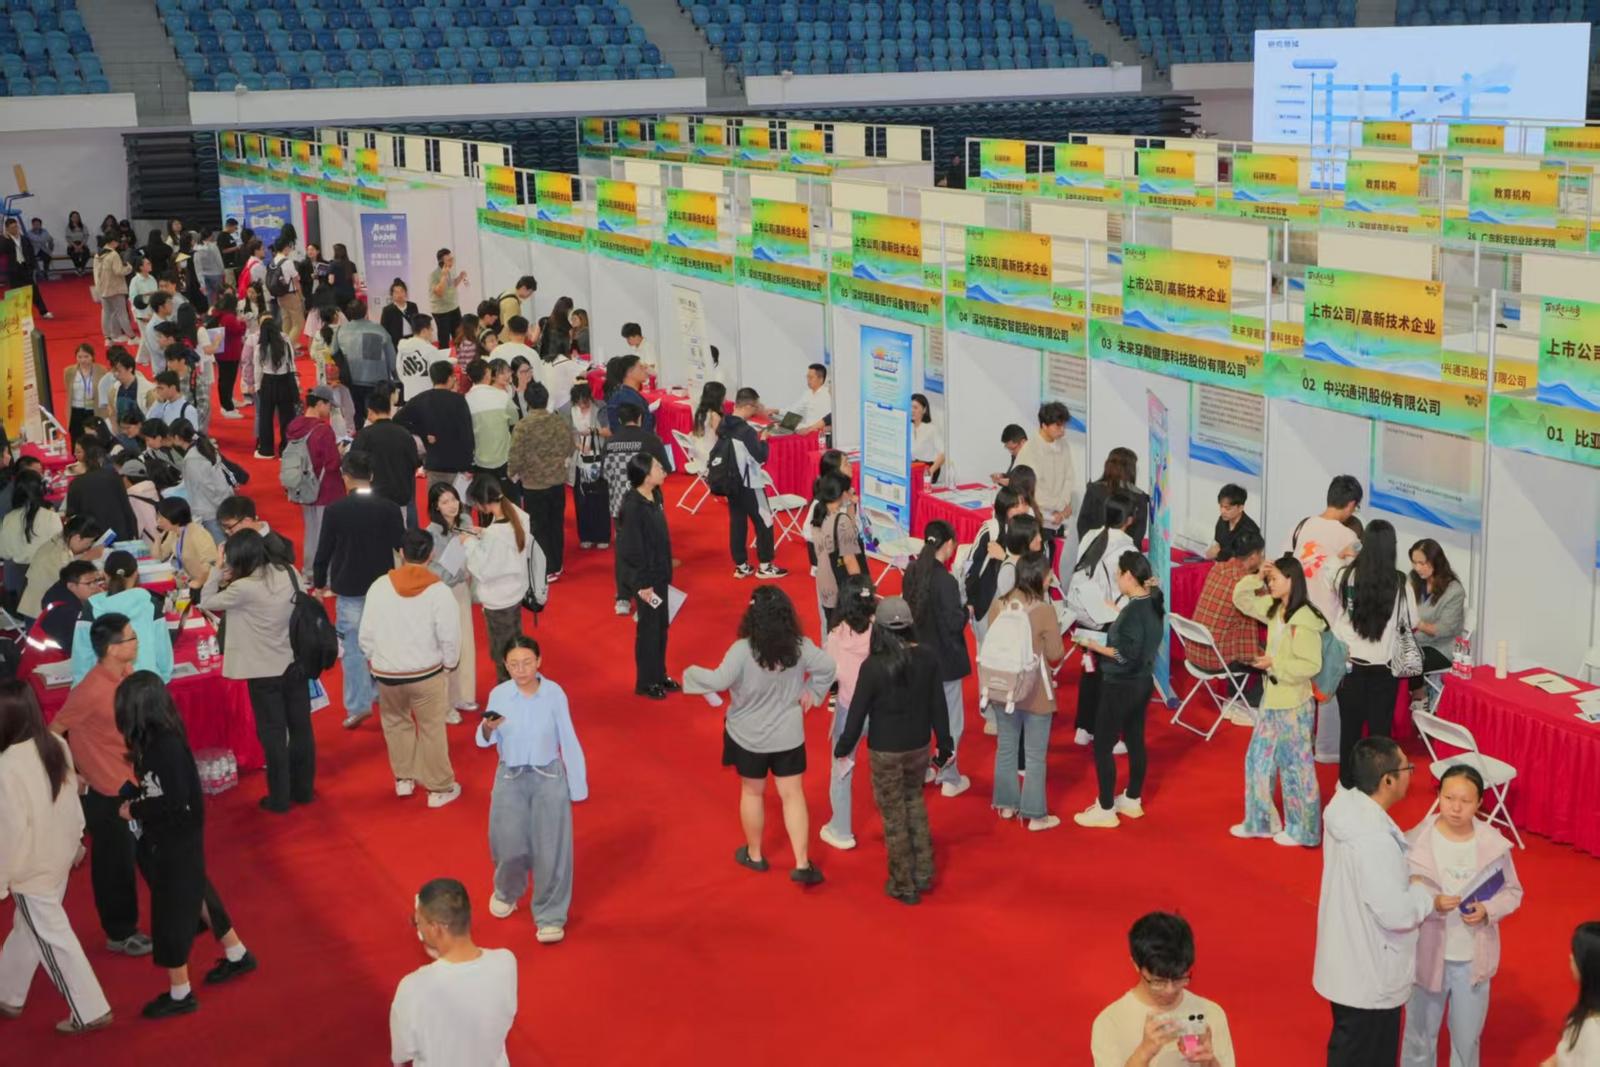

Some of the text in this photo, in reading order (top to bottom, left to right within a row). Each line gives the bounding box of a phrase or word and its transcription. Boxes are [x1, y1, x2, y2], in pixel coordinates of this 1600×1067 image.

[1366, 179, 1396, 191] 教育机构
[1494, 188, 1531, 200] 教育机构
[856, 238, 919, 257] 上市公司/高新技术企业
[1481, 233, 1556, 248] 广东新安职业技术学院
[968, 256, 1048, 276] 上市公司/高新技术企业
[1127, 275, 1227, 304] 上市公司/高新技术企业
[959, 312, 967, 322] 04
[1309, 302, 1436, 335] 上市公司/高新技术企业
[1101, 338, 1247, 379] 03 未来穿戴健康科技股份有限公司
[1303, 377, 1316, 391] 02
[1323, 380, 1441, 416] 中兴通讯股份有限公司
[1547, 426, 1564, 443] 01
